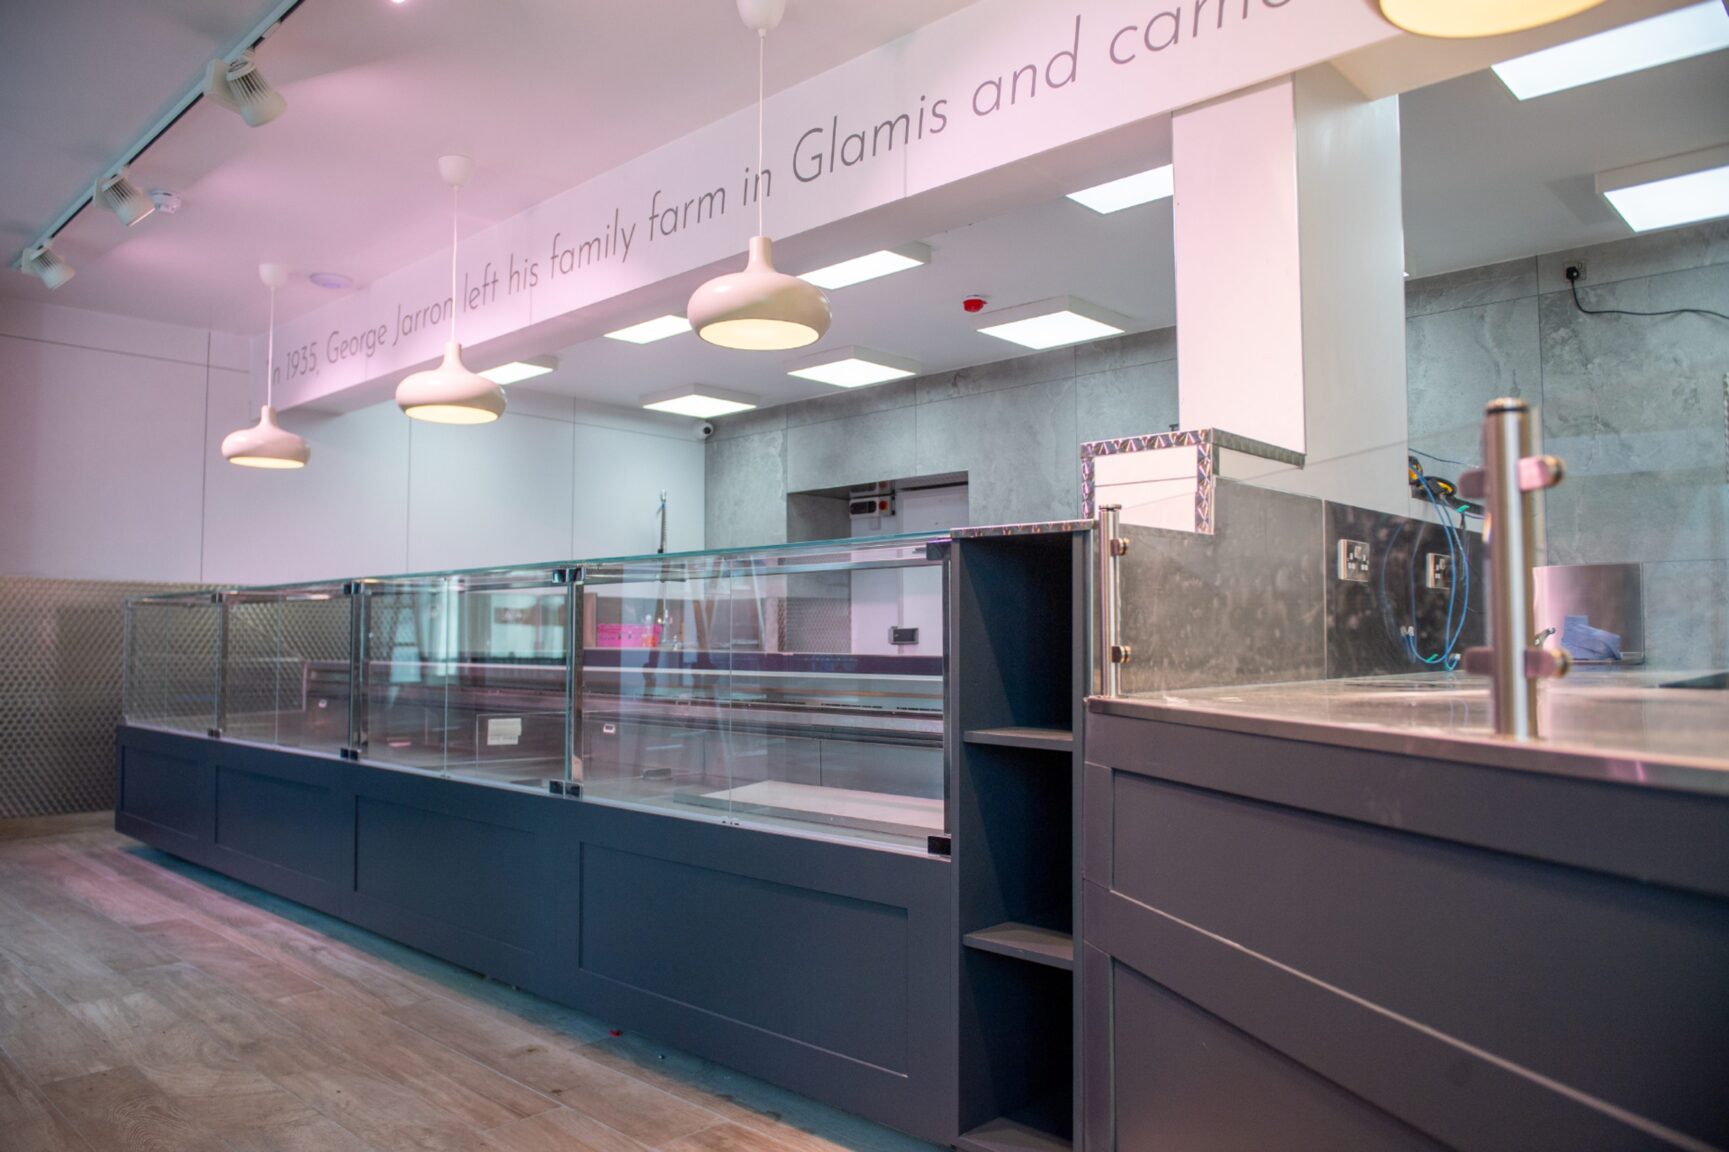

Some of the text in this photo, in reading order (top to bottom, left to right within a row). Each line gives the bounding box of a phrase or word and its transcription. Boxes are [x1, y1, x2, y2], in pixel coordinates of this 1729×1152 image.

[326, 324, 388, 364] George
[392, 297, 454, 347] Jarron
[463, 262, 500, 313] left
[508, 253, 539, 296] his
[550, 207, 636, 280] family
[648, 189, 726, 242] farm
[743, 167, 772, 206] in
[792, 95, 948, 183] Glamis
[972, 14, 1081, 117] and
[1109, 0, 1293, 65] cam
